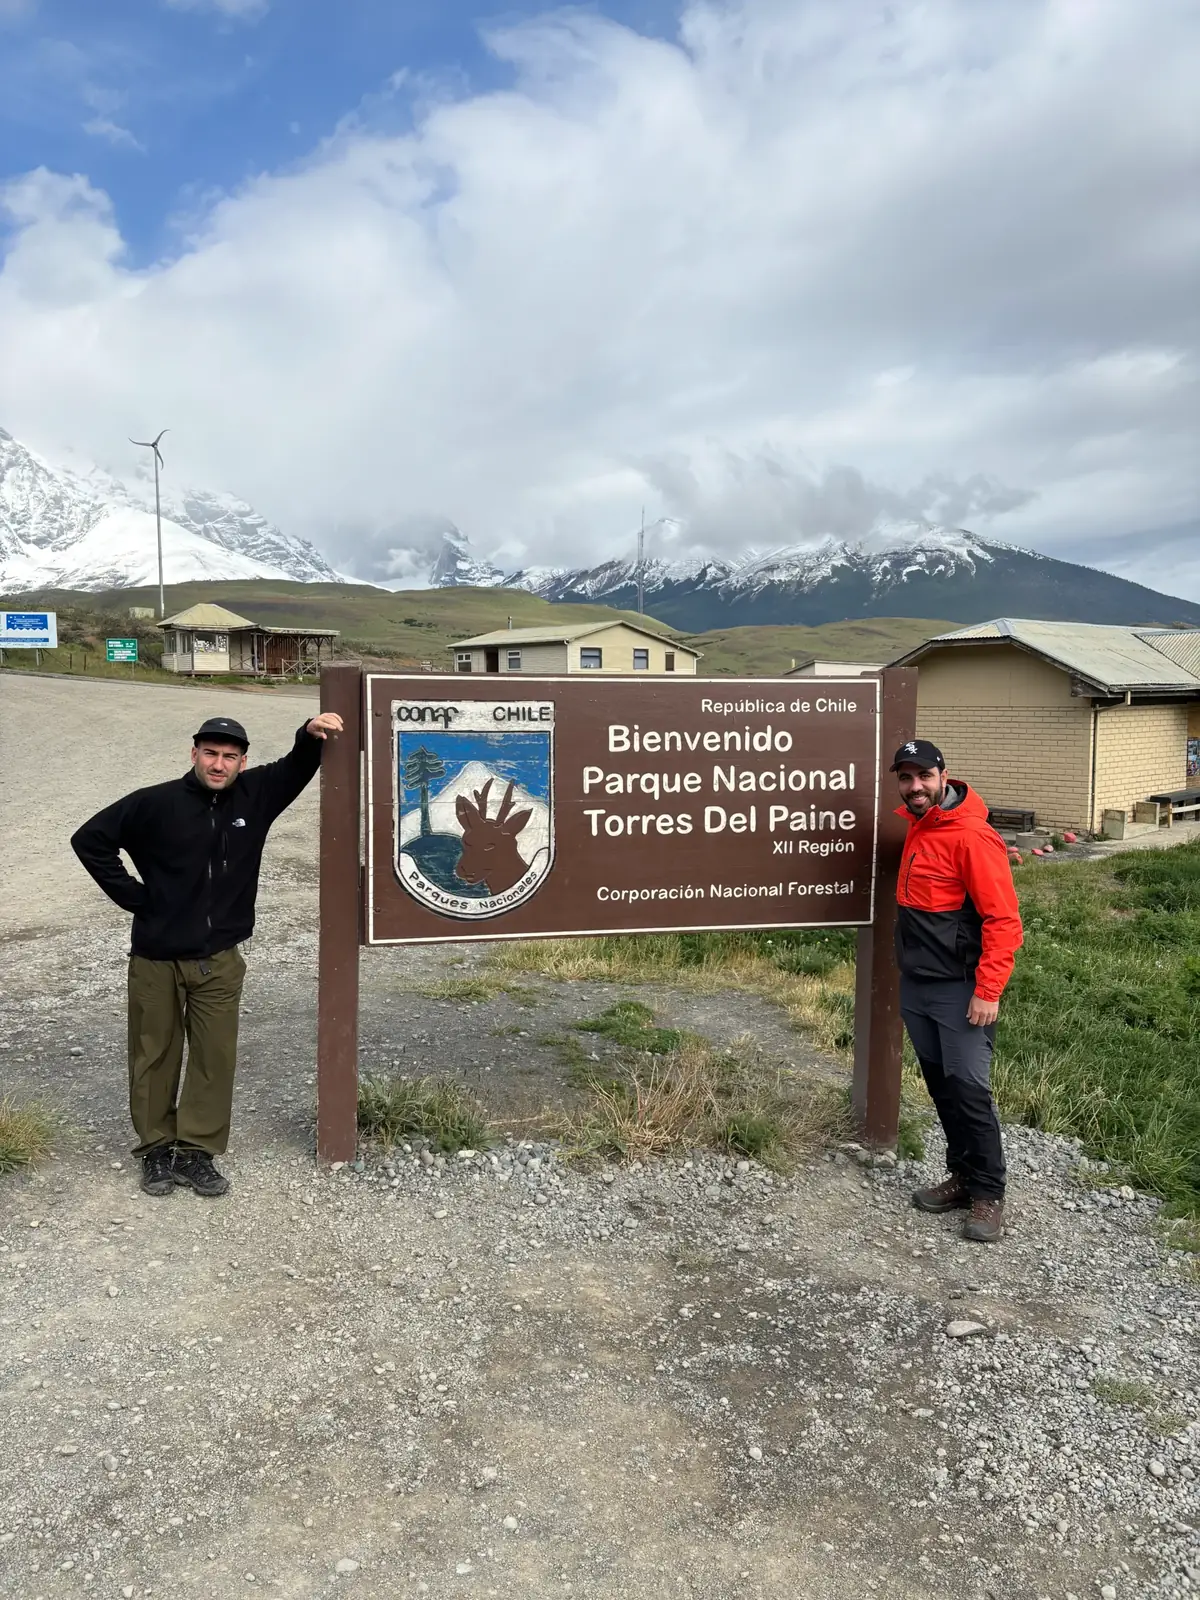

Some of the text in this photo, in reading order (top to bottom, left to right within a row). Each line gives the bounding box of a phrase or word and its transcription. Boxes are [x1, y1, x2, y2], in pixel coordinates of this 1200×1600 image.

[493, 706, 551, 722] CHILE
[701, 698, 857, 716] República de Chile
[608, 725, 793, 752] Bienvenido
[582, 763, 856, 800] Parque Nacional
[583, 804, 856, 836] Torres Del Paine
[772, 839, 855, 856] XII Región
[409, 870, 538, 911] Parques Nacionales
[596, 881, 854, 903] Corporación Nacional Forestal
